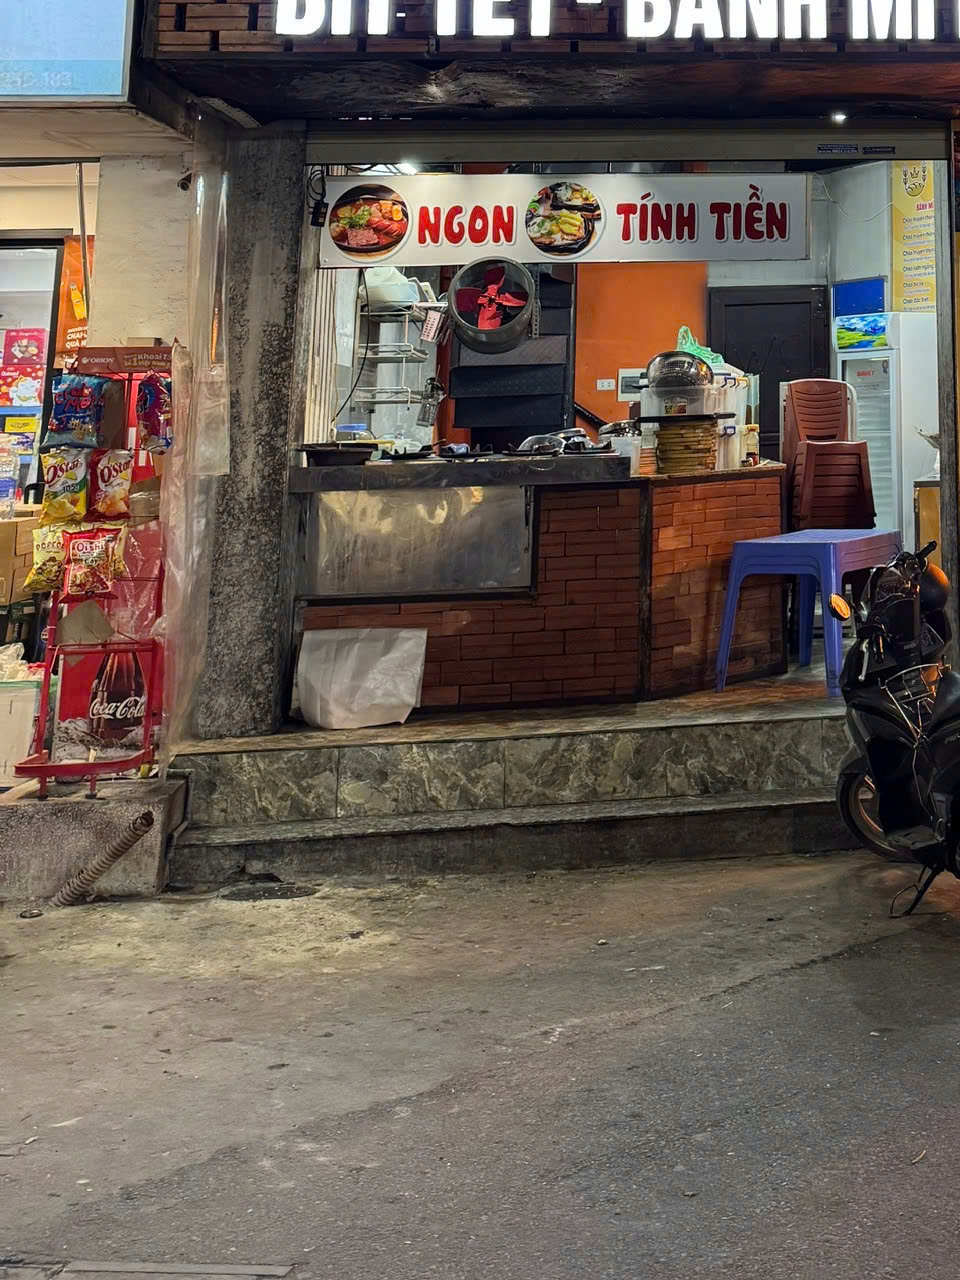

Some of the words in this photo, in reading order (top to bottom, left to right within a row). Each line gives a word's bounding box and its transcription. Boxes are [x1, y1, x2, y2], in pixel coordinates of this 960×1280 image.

[418, 204, 517, 247] NGON
[616, 191, 698, 243] TÍNH
[709, 183, 790, 243] TIỀN
[45, 459, 81, 484] O'Star
[100, 460, 131, 484] O'Star
[76, 541, 105, 552] Oishi
